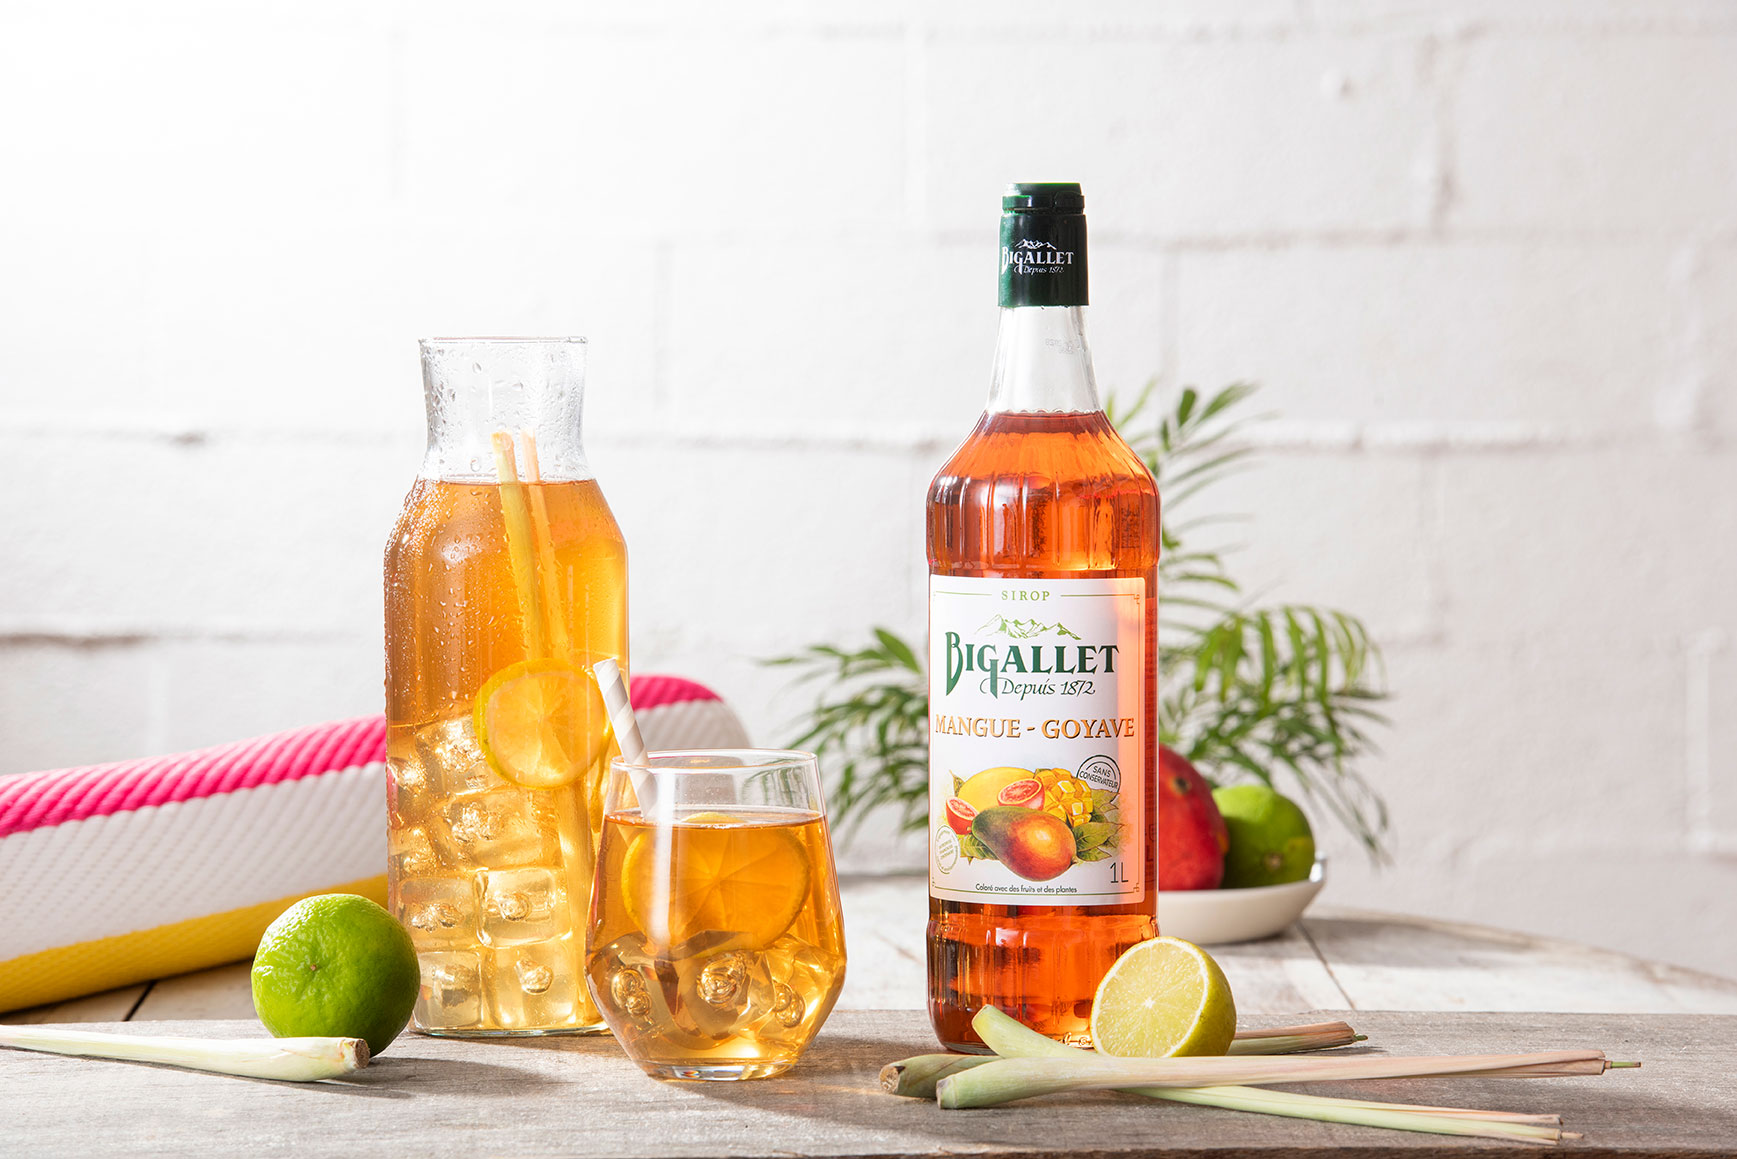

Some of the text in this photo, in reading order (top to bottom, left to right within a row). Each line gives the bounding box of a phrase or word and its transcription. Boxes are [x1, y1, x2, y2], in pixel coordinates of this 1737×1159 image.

[1001, 246, 1075, 275] BIGALLET
[1020, 265, 1047, 275] Depuis
[1001, 590, 1050, 601] SIROP
[945, 631, 1119, 699] BIGALLET
[998, 677, 1096, 701] Depuis 1872
[935, 714, 1021, 738] MANGUE
[1041, 717, 1135, 739] GOYAVE
[1079, 770, 1118, 788] CONSERVATEUR
[1092, 765, 1112, 778] SANS
[1109, 862, 1129, 884] 1L
[975, 883, 994, 892] Coloré
[1009, 885, 1019, 893] des
[1020, 885, 1036, 893] fruits
[1044, 885, 1054, 893] des
[1055, 885, 1077, 894] plantes
